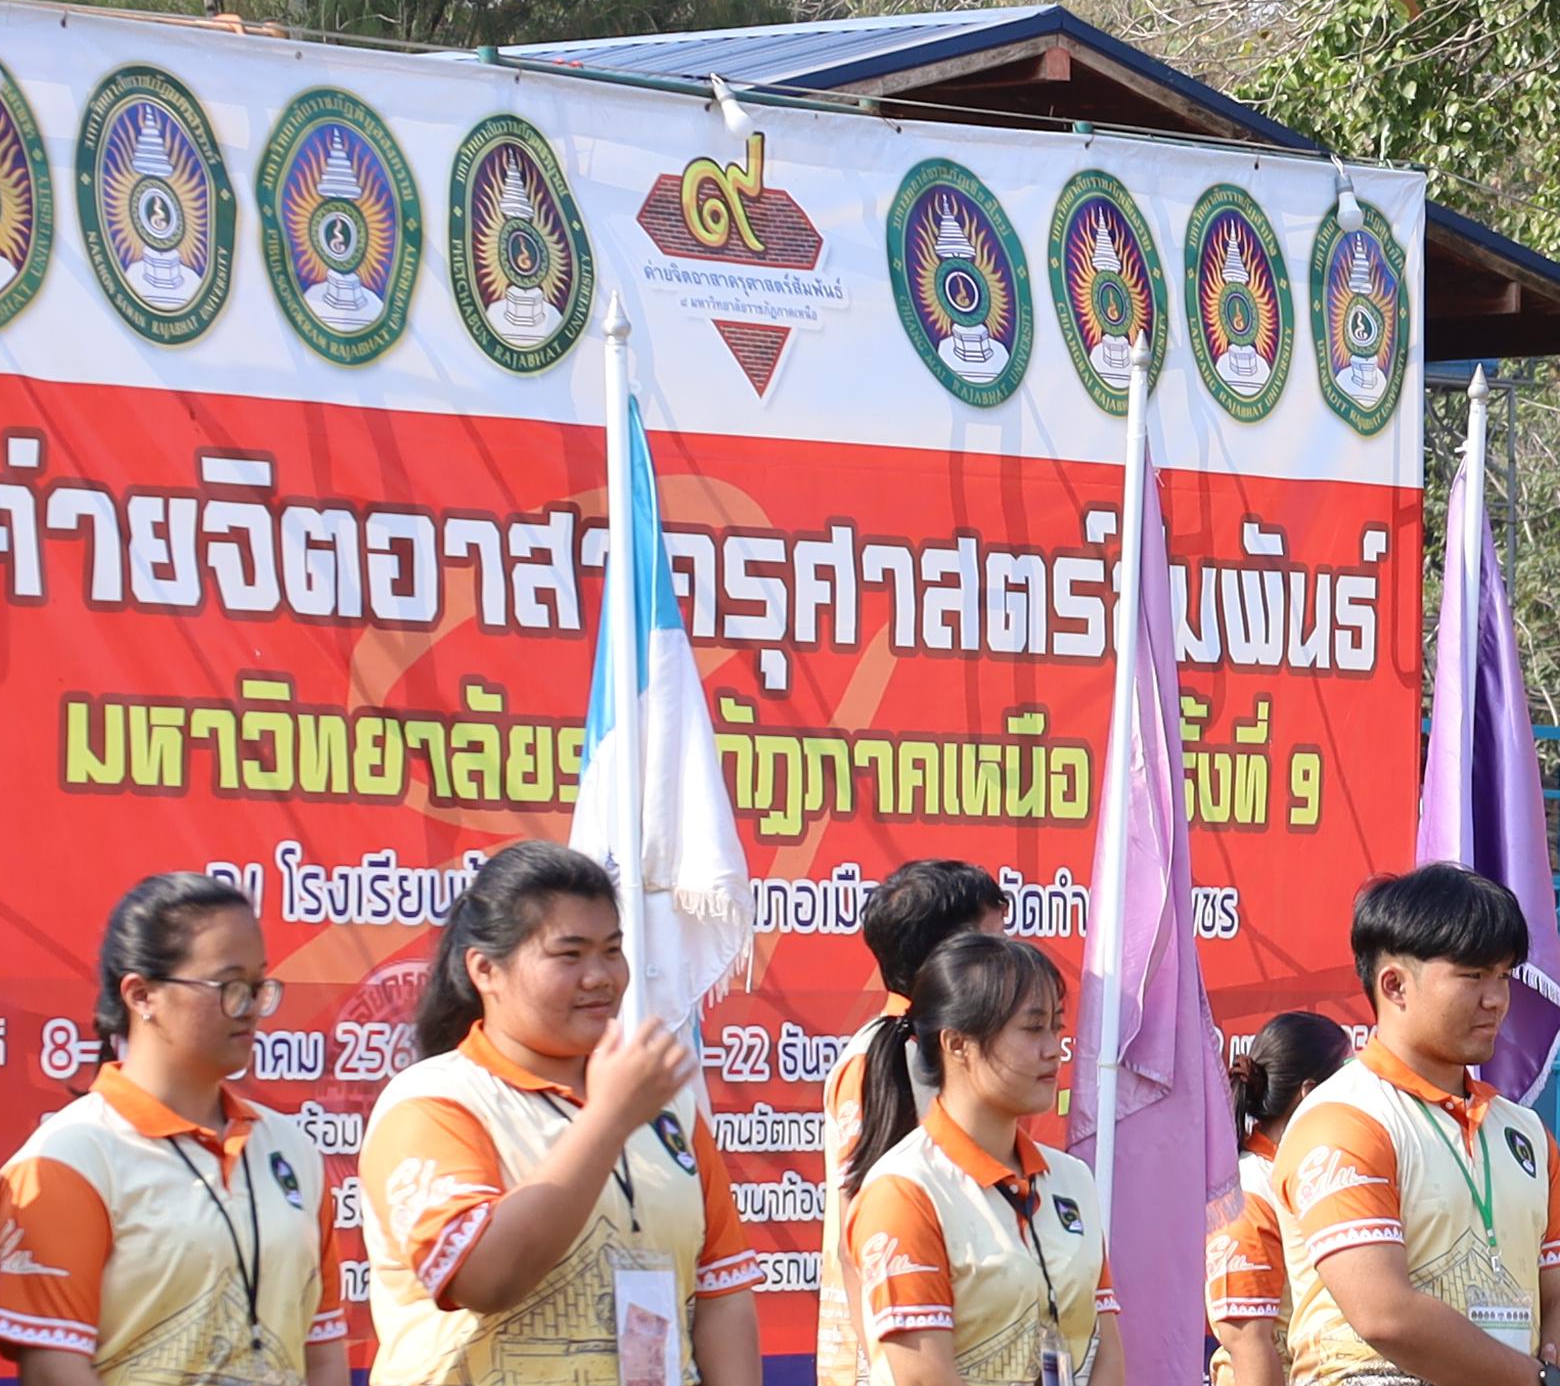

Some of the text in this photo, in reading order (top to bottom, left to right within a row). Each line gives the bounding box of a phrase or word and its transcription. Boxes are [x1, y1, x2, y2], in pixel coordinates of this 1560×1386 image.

[31, 175, 56, 278] UNIVERSITY
[680, 131, 767, 253] ๙
[87, 230, 229, 339] NAKHON SAWAN RAJABHAT UNIVERSITY
[267, 229, 417, 362] PIBULSONGKRAM RAJABHAT UNIVERSITY
[452, 238, 593, 370] PHETCHABUN RAJABHAT UNIVERSITY
[643, 259, 843, 301] ค่ายจิตอาสาครุศาสตร์สัมพันธ์
[899, 294, 1033, 406] CHIANG MAI RAJABHAT UNIVERSITY
[1190, 316, 1292, 418] LAMPANG RAJABHAT UNIVERSITY
[1380, 348, 1406, 417] UNIVERSITY
